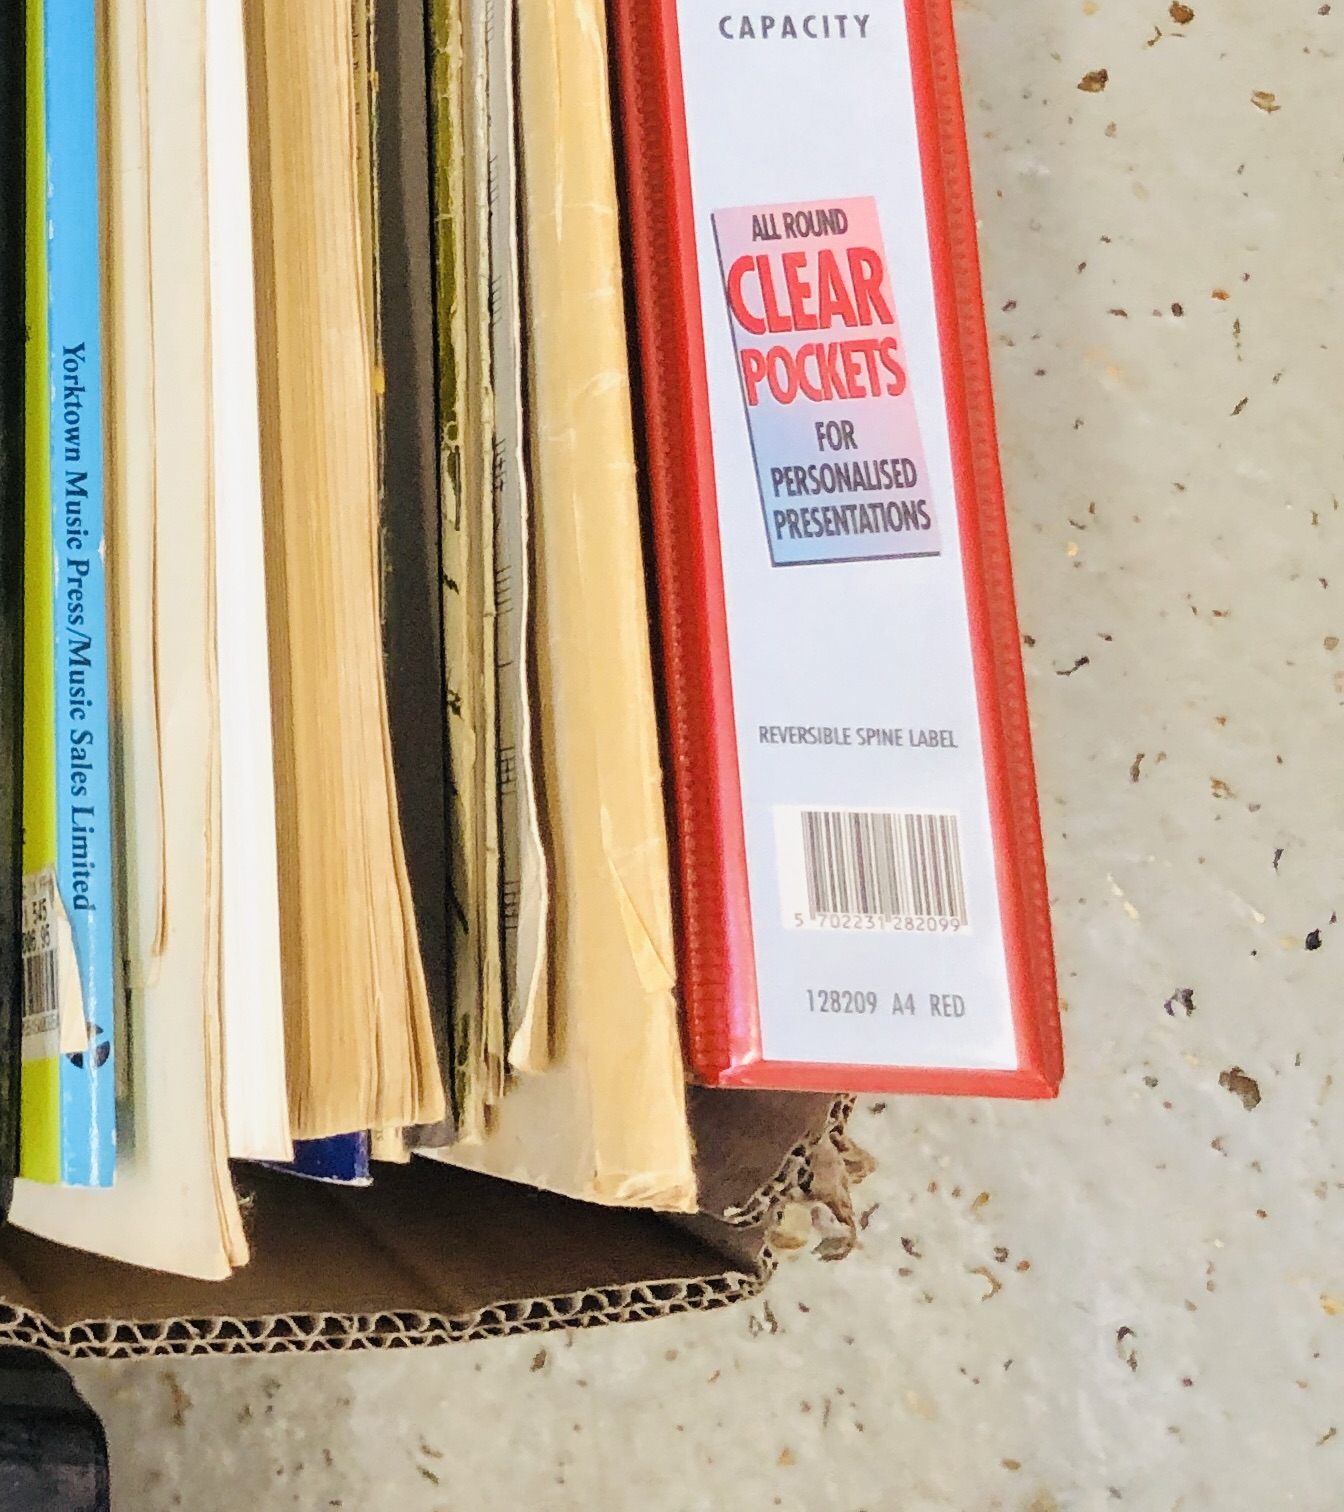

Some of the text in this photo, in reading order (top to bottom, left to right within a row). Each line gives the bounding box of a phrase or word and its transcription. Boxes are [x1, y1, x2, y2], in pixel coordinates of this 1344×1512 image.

[718, 13, 872, 40] CAPACITY
[751, 207, 849, 242] ALL ROUND
[726, 246, 894, 335] CLEAR
[740, 336, 907, 406] POCKETS
[815, 419, 858, 452] FOR
[770, 457, 918, 498] PERSONALISED
[772, 498, 932, 541] PRESENTATIONS
[61, 342, 96, 911] Yorktown Music Press/Music Sales Limited
[758, 726, 960, 749] REVERSIBLE SPINE LABEL
[794, 912, 961, 933] 5 702231 282099
[806, 989, 967, 1019] 128209 A4 RED
